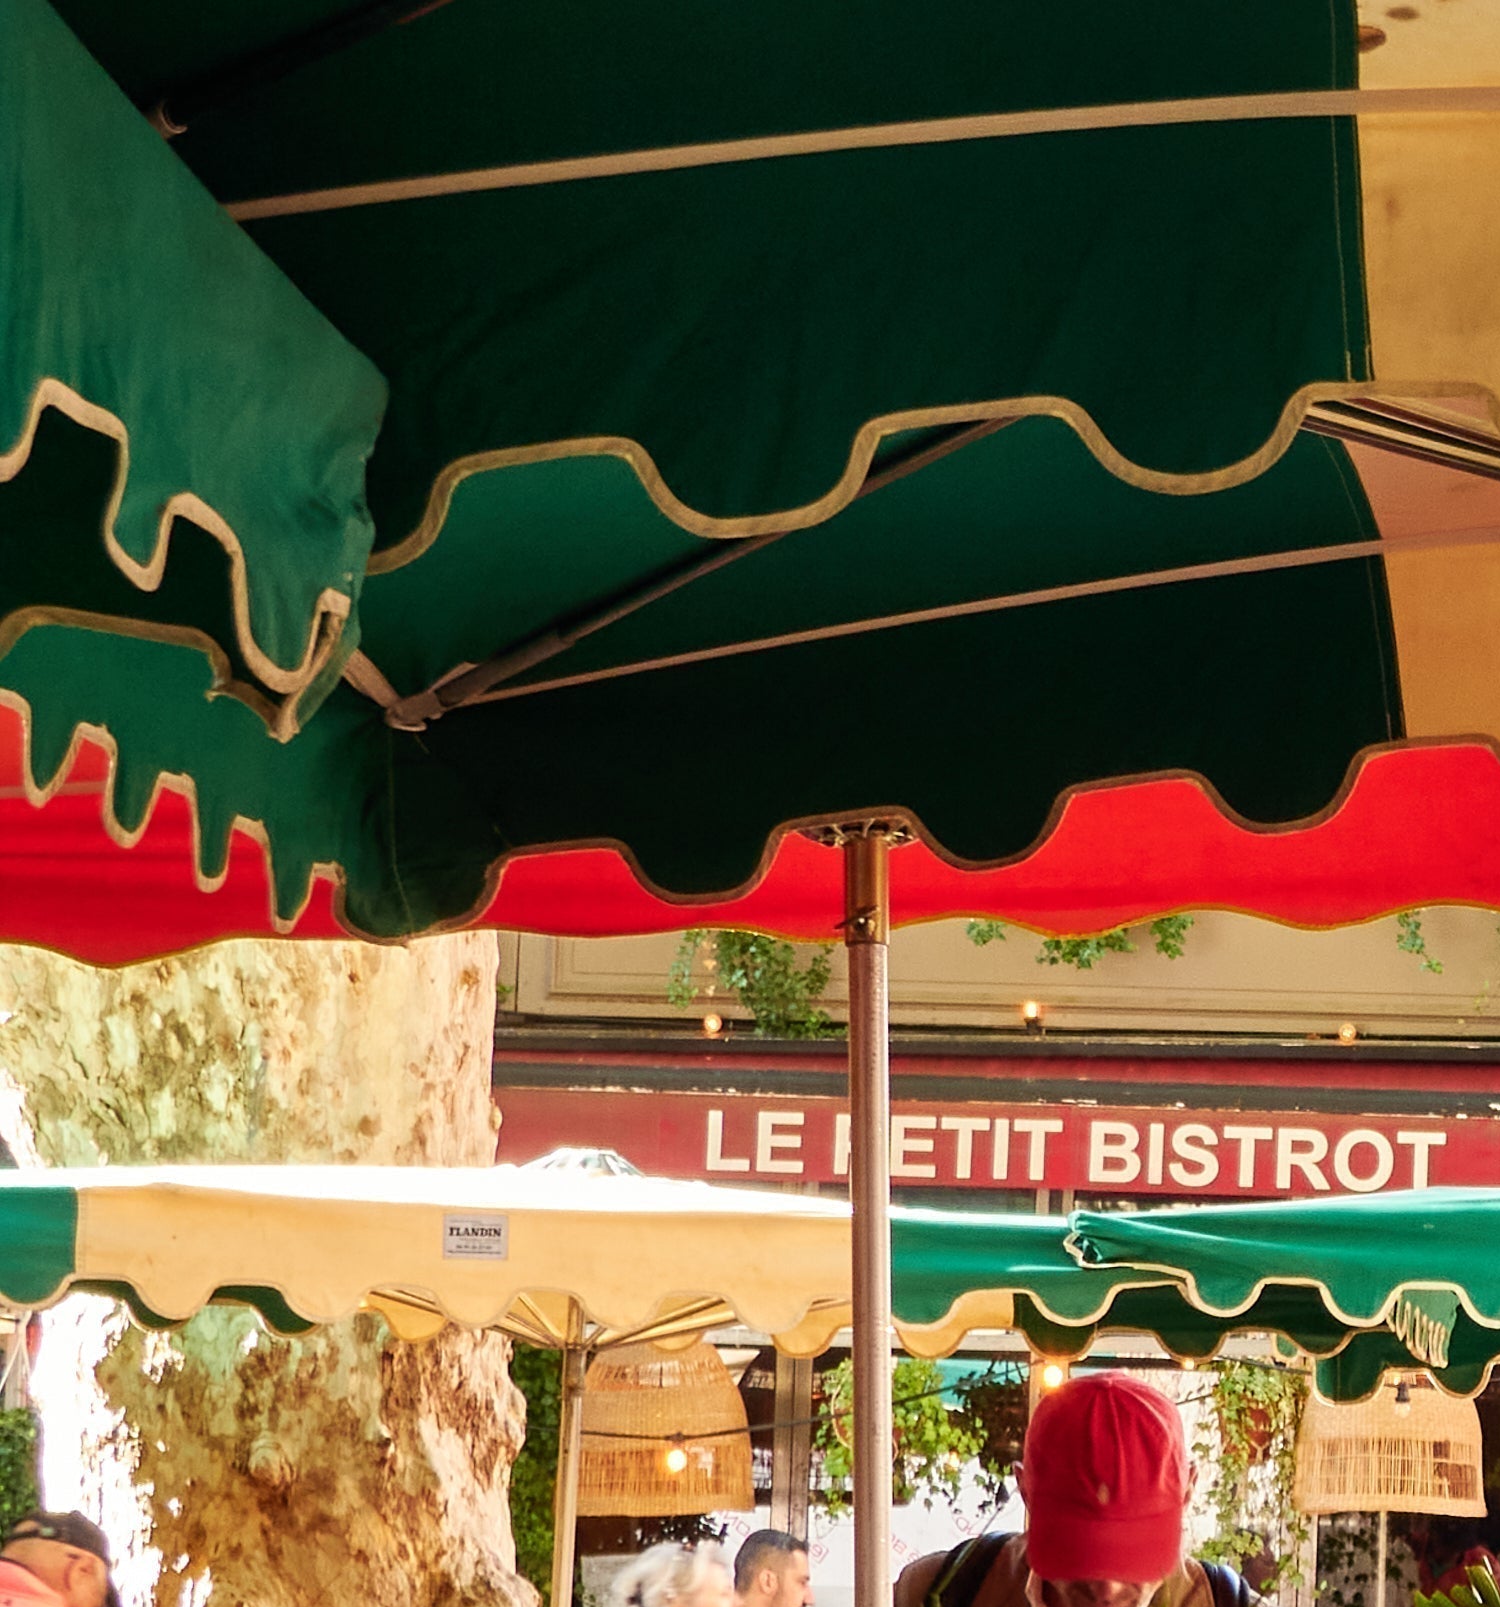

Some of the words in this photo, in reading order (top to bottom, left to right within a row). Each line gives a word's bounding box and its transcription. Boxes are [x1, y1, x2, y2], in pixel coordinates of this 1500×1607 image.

[706, 1109, 804, 1173] LE
[1088, 1120, 1447, 1193] BISTROT
[449, 1226, 502, 1237] FLANDIN
